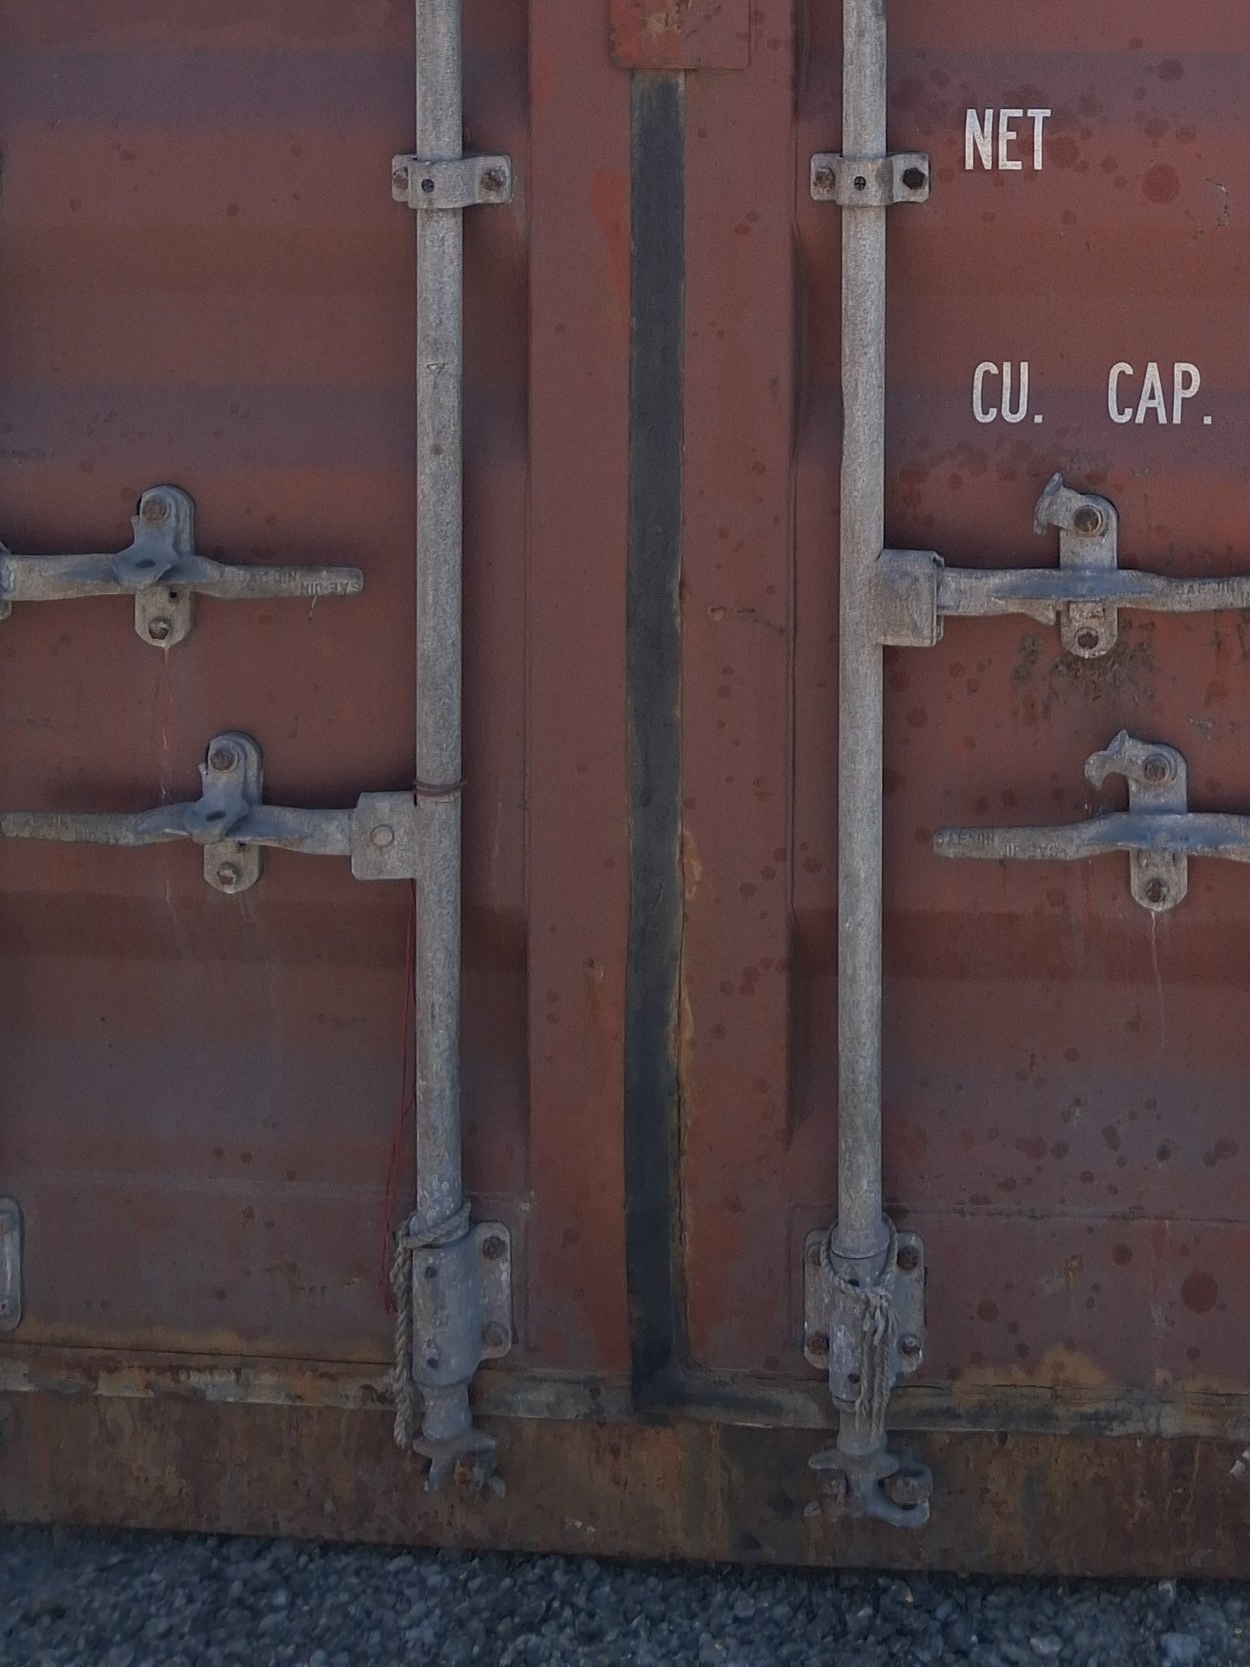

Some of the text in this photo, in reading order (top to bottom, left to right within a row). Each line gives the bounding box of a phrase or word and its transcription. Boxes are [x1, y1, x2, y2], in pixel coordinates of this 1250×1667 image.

[965, 108, 1052, 171] NET
[972, 361, 1212, 425] CU. CAP.
